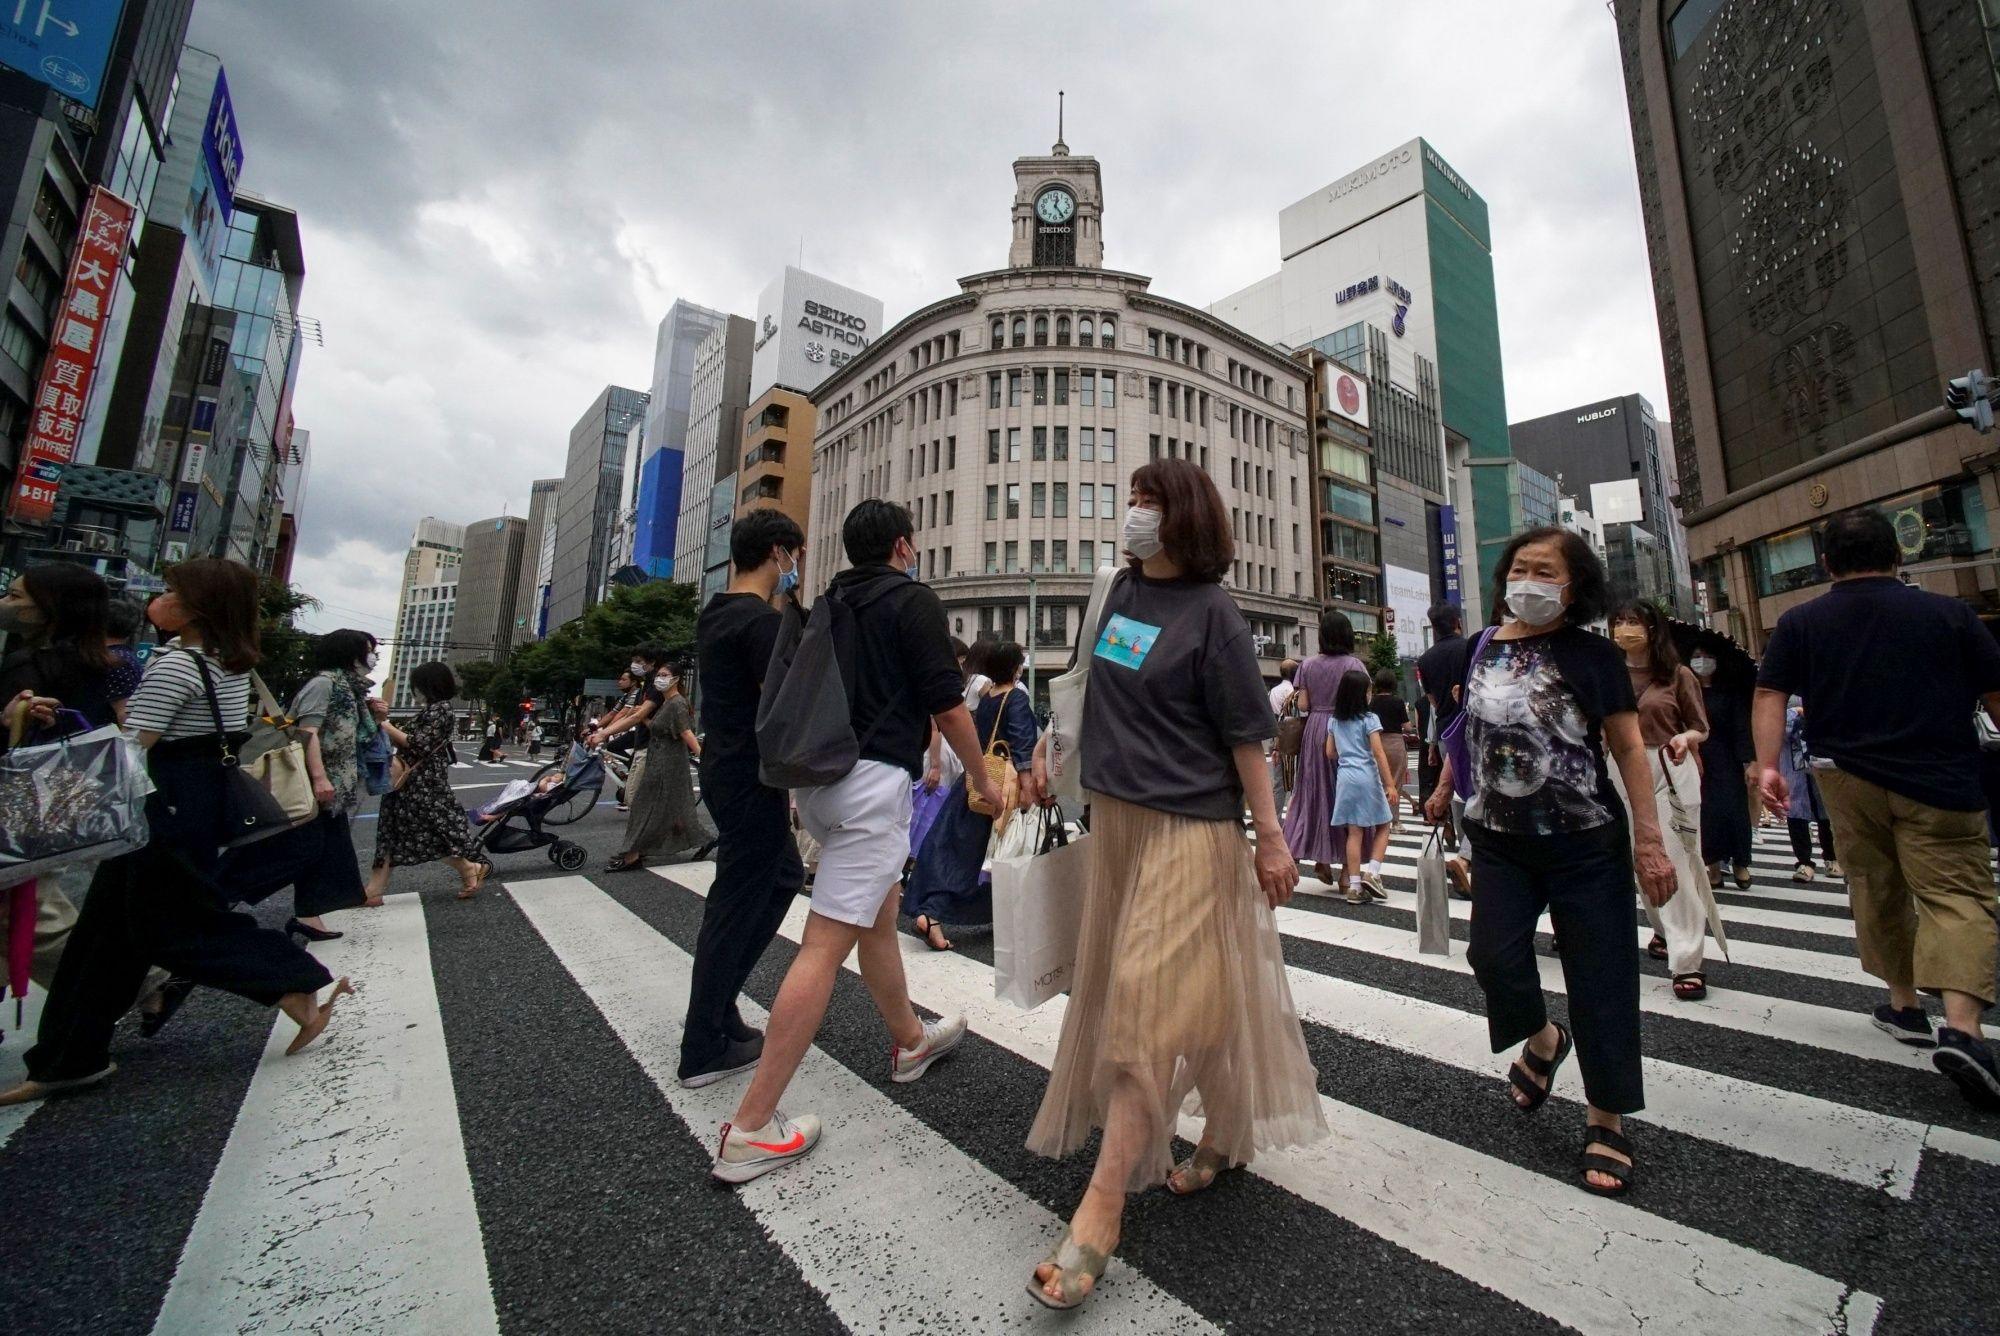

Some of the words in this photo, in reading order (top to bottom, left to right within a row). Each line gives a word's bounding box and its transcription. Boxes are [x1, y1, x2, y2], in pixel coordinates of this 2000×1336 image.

[1328, 150, 1412, 202] MIKIMOTO
[1426, 148, 1473, 200] MIKIMOTO
[91, 207, 126, 233] ブランド
[99, 227, 110, 237] &
[1039, 226, 1071, 234] SEIKO
[798, 315, 870, 349] ASTRON
[804, 299, 867, 332] SEIKO
[50, 358, 86, 392] 質
[40, 382, 83, 418] 買取
[1577, 406, 1617, 424] HUBLOT
[36, 409, 77, 442] 販売
